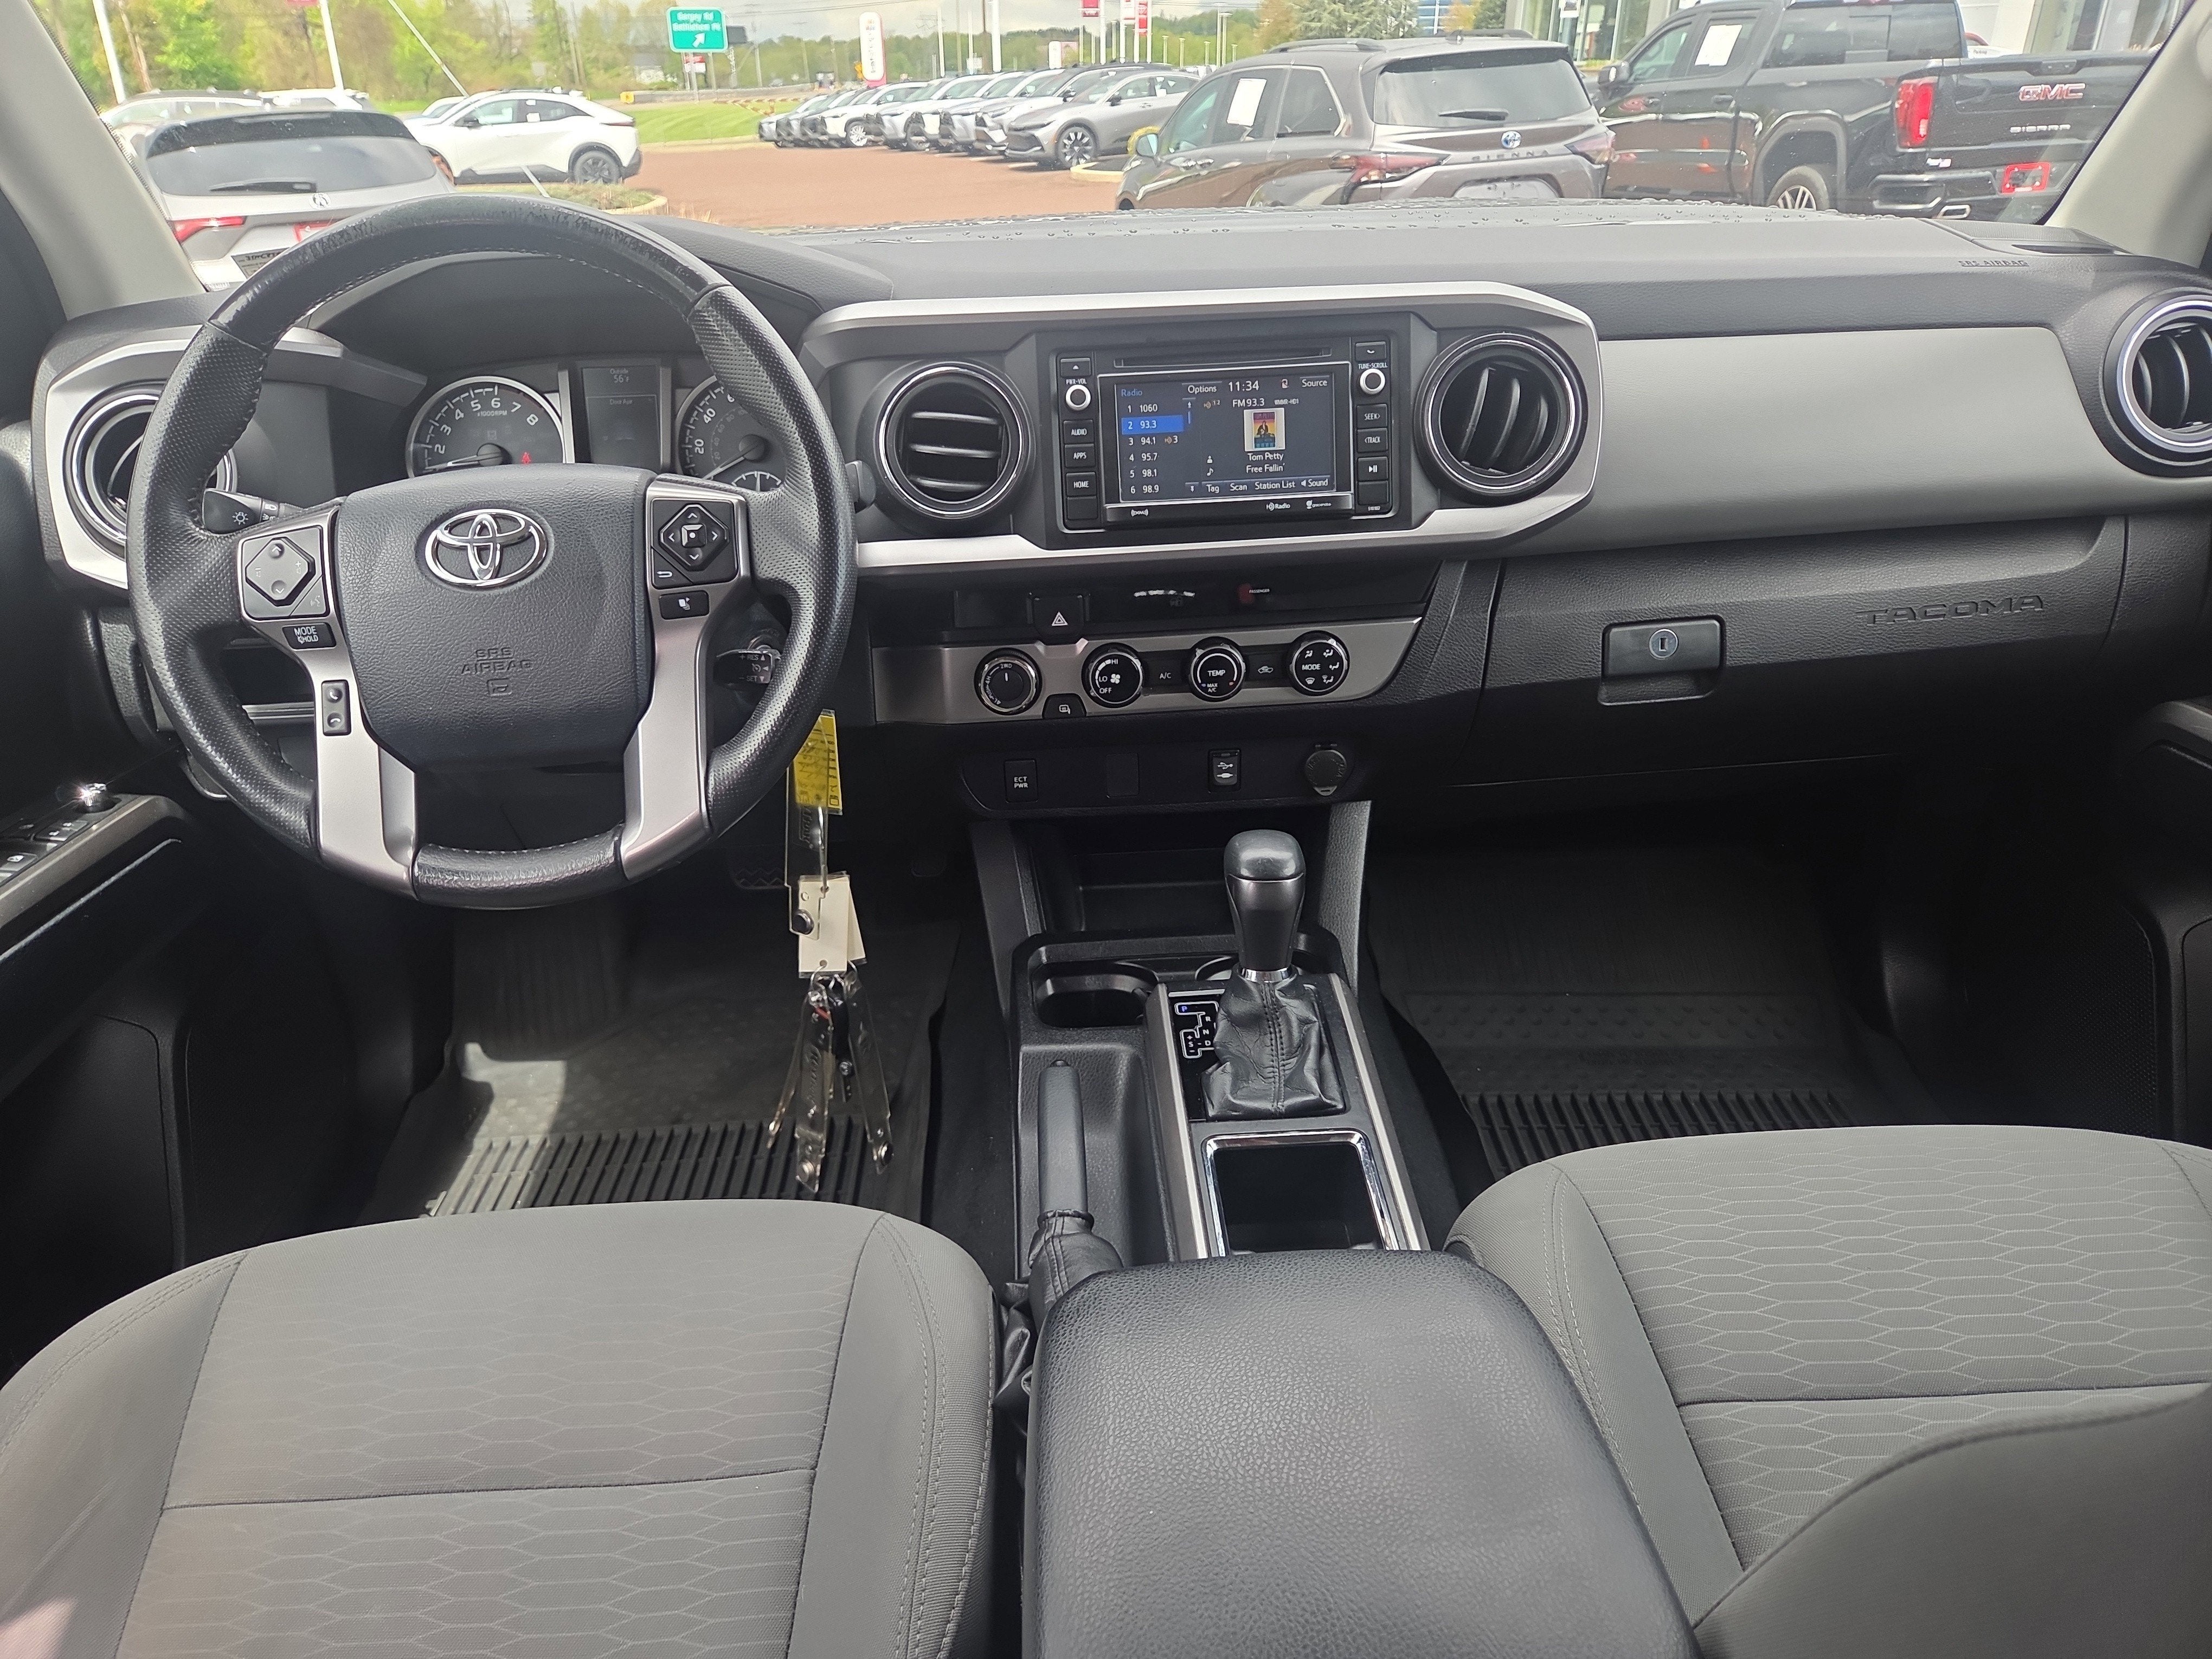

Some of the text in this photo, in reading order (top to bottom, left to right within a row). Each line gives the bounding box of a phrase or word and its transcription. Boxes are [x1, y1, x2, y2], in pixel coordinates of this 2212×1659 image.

[2019, 83, 2086, 101] GMC
[2010, 124, 2071, 133] SIERRA
[1228, 380, 1259, 392] 11:34
[1302, 378, 1328, 388] Source
[1121, 389, 1142, 397] Radio
[1187, 385, 1217, 394] Options
[491, 397, 501, 409] 6
[727, 394, 735, 403] 6
[471, 399, 481, 411] 5
[511, 402, 522, 413] 7
[1128, 404, 1158, 413] 1 1060
[455, 409, 464, 420] 4
[703, 408, 716, 423] 40
[526, 414, 539, 426] 8
[1128, 420, 1157, 430] 2 93.3
[440, 425, 452, 436] 3
[1129, 438, 1134, 446] 3
[1141, 436, 1156, 445] 94.1
[434, 444, 446, 454] 2
[695, 439, 704, 454] 20
[1129, 452, 1158, 462] 4 95.7
[1265, 452, 1284, 461] Petty
[1130, 468, 1158, 478] 5 98.1
[1246, 465, 1262, 473] Free
[1230, 483, 1248, 491] Scan
[1255, 480, 1295, 490] Station List
[1308, 478, 1328, 487] Sound
[1130, 484, 1159, 494] 6 98.9
[1206, 484, 1220, 493] Tag
[1854, 595, 2043, 626] TACOMA
[293, 626, 317, 636] MODE
[304, 634, 319, 642] HOLD
[475, 647, 514, 659] SRS
[461, 659, 533, 675] AIRBAG
[1207, 669, 1226, 677] TEMP
